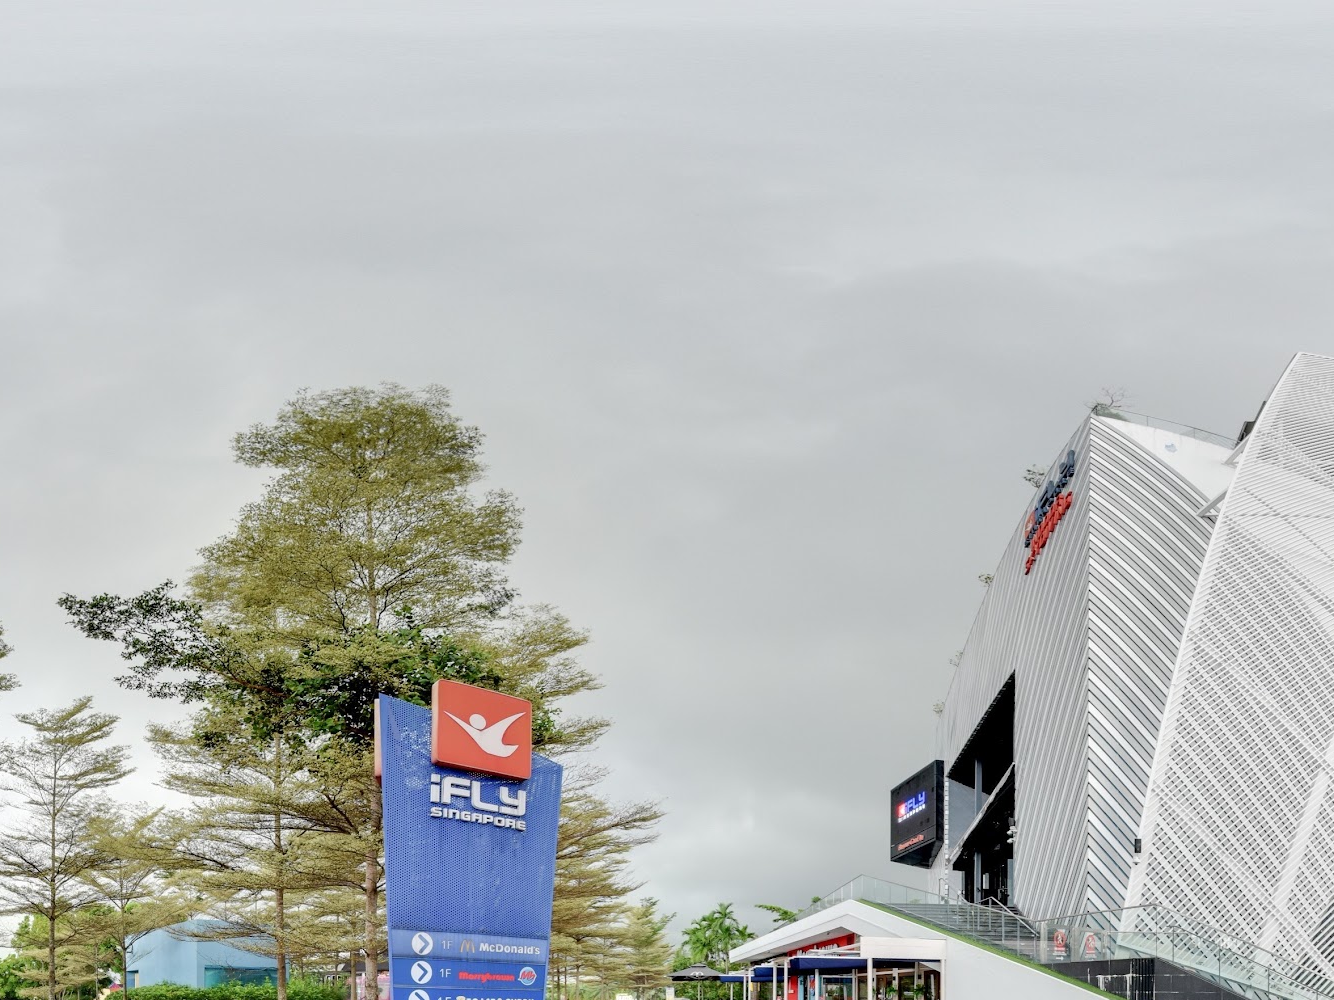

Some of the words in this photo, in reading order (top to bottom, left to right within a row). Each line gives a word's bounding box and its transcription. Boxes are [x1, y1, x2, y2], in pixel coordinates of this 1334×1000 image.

[430, 773, 526, 816] iFLY
[430, 807, 526, 831] SINGAPORE
[442, 941, 453, 950] 1F
[479, 943, 541, 955] McDonald's
[440, 968, 452, 978] 1F
